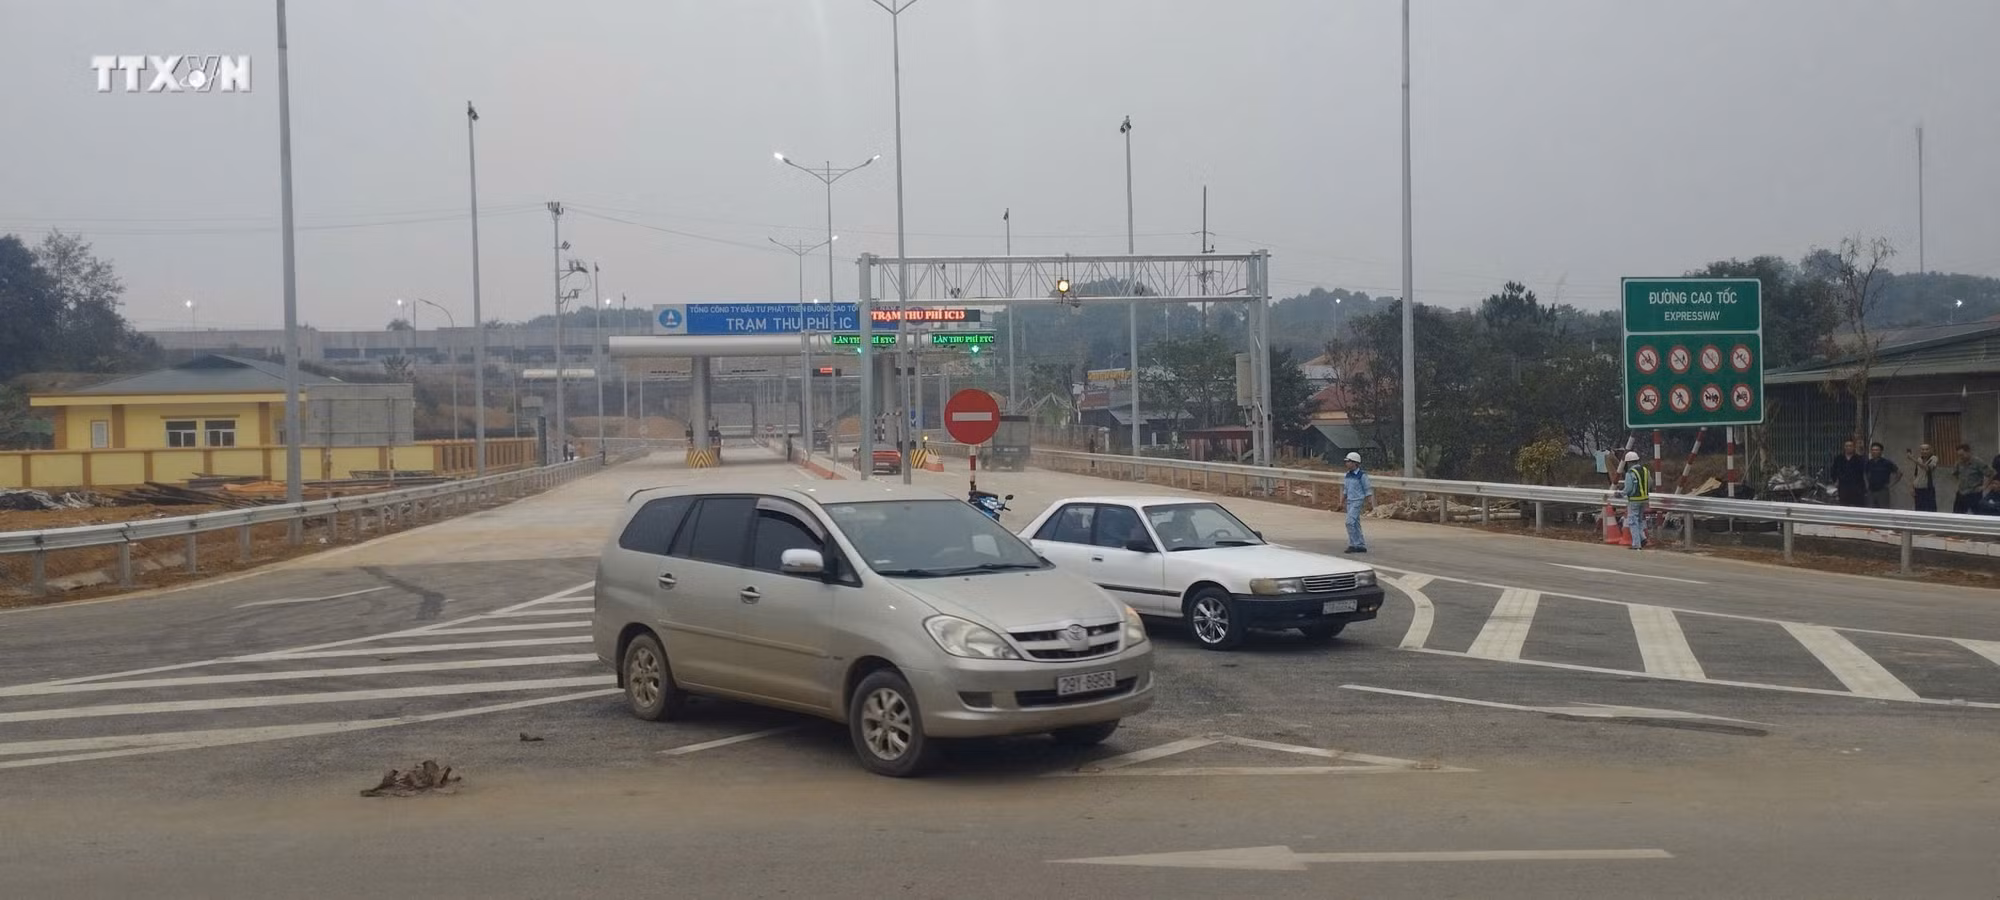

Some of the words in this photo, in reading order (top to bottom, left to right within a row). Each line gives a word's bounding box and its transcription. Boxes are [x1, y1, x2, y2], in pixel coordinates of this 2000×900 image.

[1648, 288, 1687, 304] ĐƯỜNG
[1690, 291, 1713, 304] CAO
[1716, 287, 1738, 304] TỐC
[710, 304, 730, 313] CÔNG
[731, 305, 741, 313] TY
[755, 304, 766, 313] TƯ
[766, 303, 787, 313] PHÁT
[833, 304, 846, 312] CAO
[847, 303, 859, 312] TỐ
[871, 310, 901, 322] TRẠM
[904, 310, 924, 320] THU
[925, 309, 942, 320] PHÍ
[944, 310, 965, 320] IC13
[1664, 311, 1720, 321] EXPRESSWAY
[726, 318, 767, 333] TRẠM
[773, 317, 800, 330] THU
[807, 313, 829, 330] PHÍ
[833, 335, 848, 344] LÀN
[880, 336, 895, 344] ETC
[933, 335, 948, 343] LÀN
[965, 334, 978, 343] PHÍ
[979, 335, 994, 343] ETC
